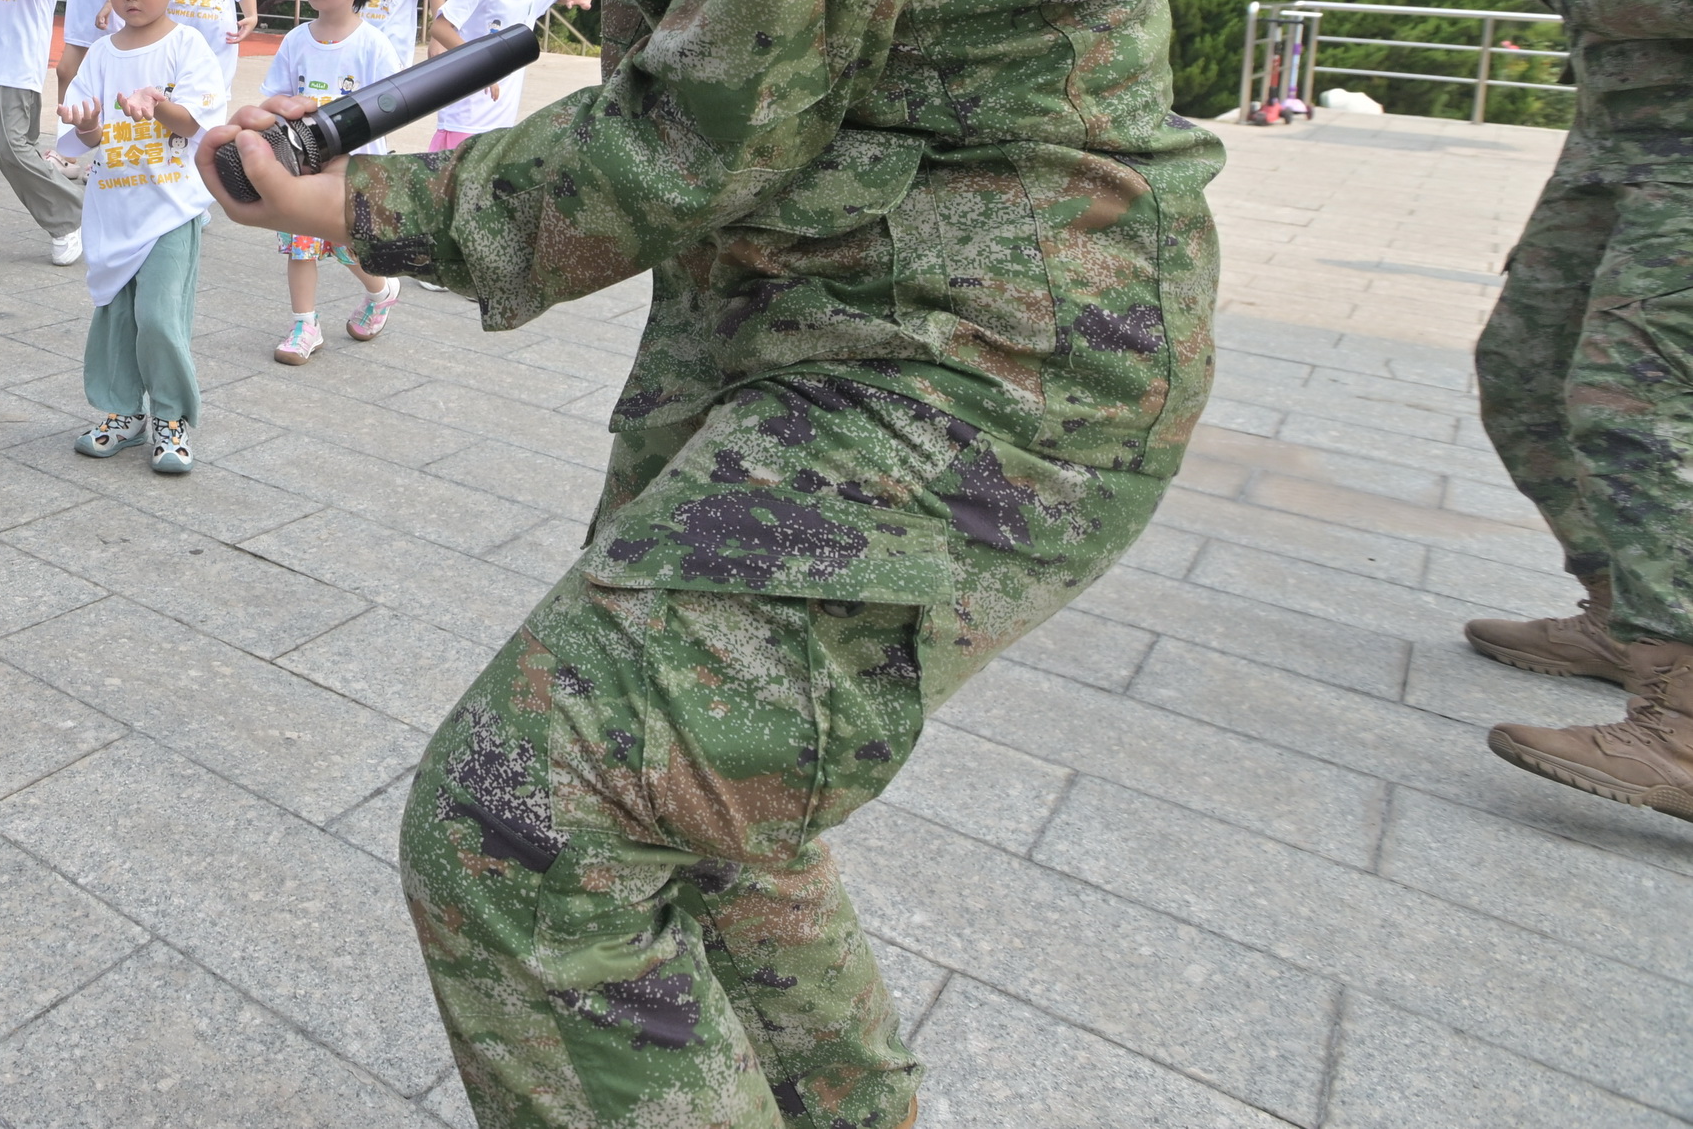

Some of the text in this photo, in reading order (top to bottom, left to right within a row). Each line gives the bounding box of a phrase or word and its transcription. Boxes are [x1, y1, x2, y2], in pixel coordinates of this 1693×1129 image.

[105, 142, 164, 169] 夏令营
[97, 174, 148, 190] SUMMER
